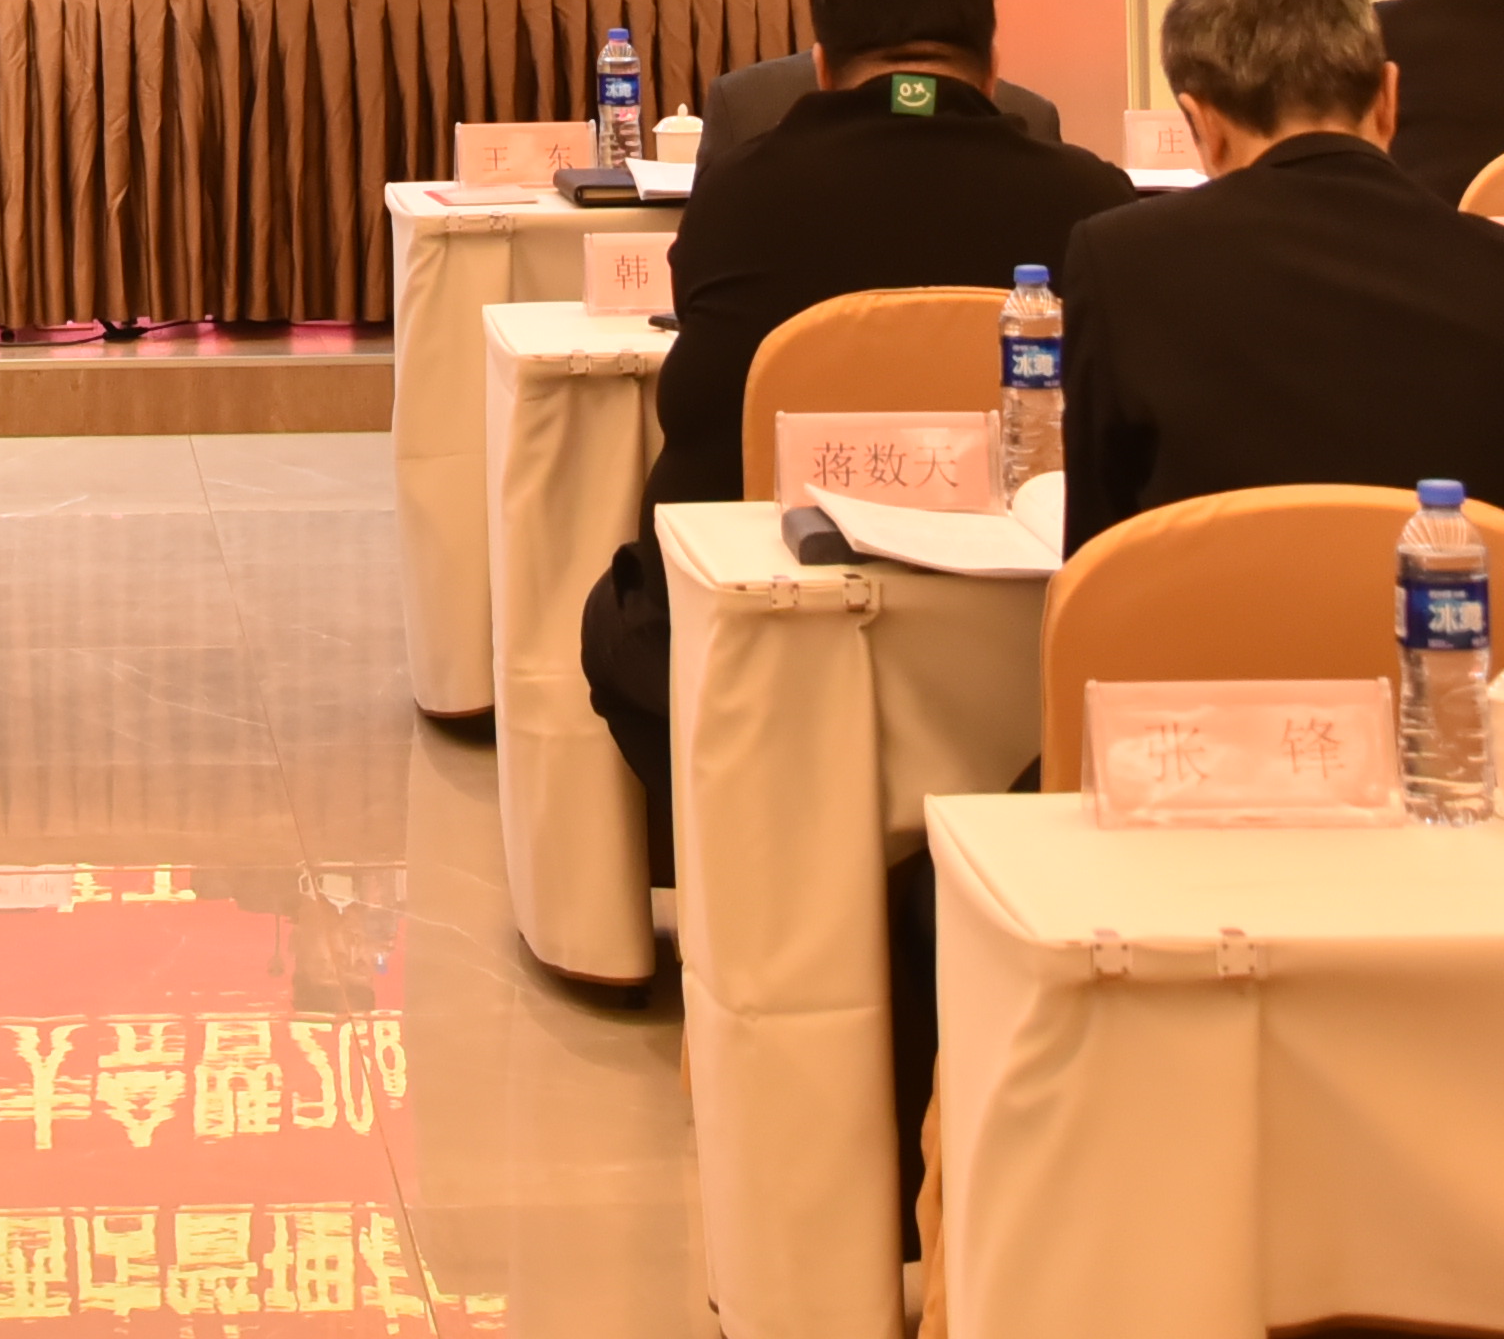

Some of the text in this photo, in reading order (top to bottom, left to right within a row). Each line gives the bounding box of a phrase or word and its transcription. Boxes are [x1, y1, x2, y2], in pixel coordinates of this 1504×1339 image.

[1156, 125, 1186, 156] 庄
[613, 253, 649, 291] 韩
[811, 440, 960, 489] 蒋数天
[1143, 716, 1347, 785] 张锋
